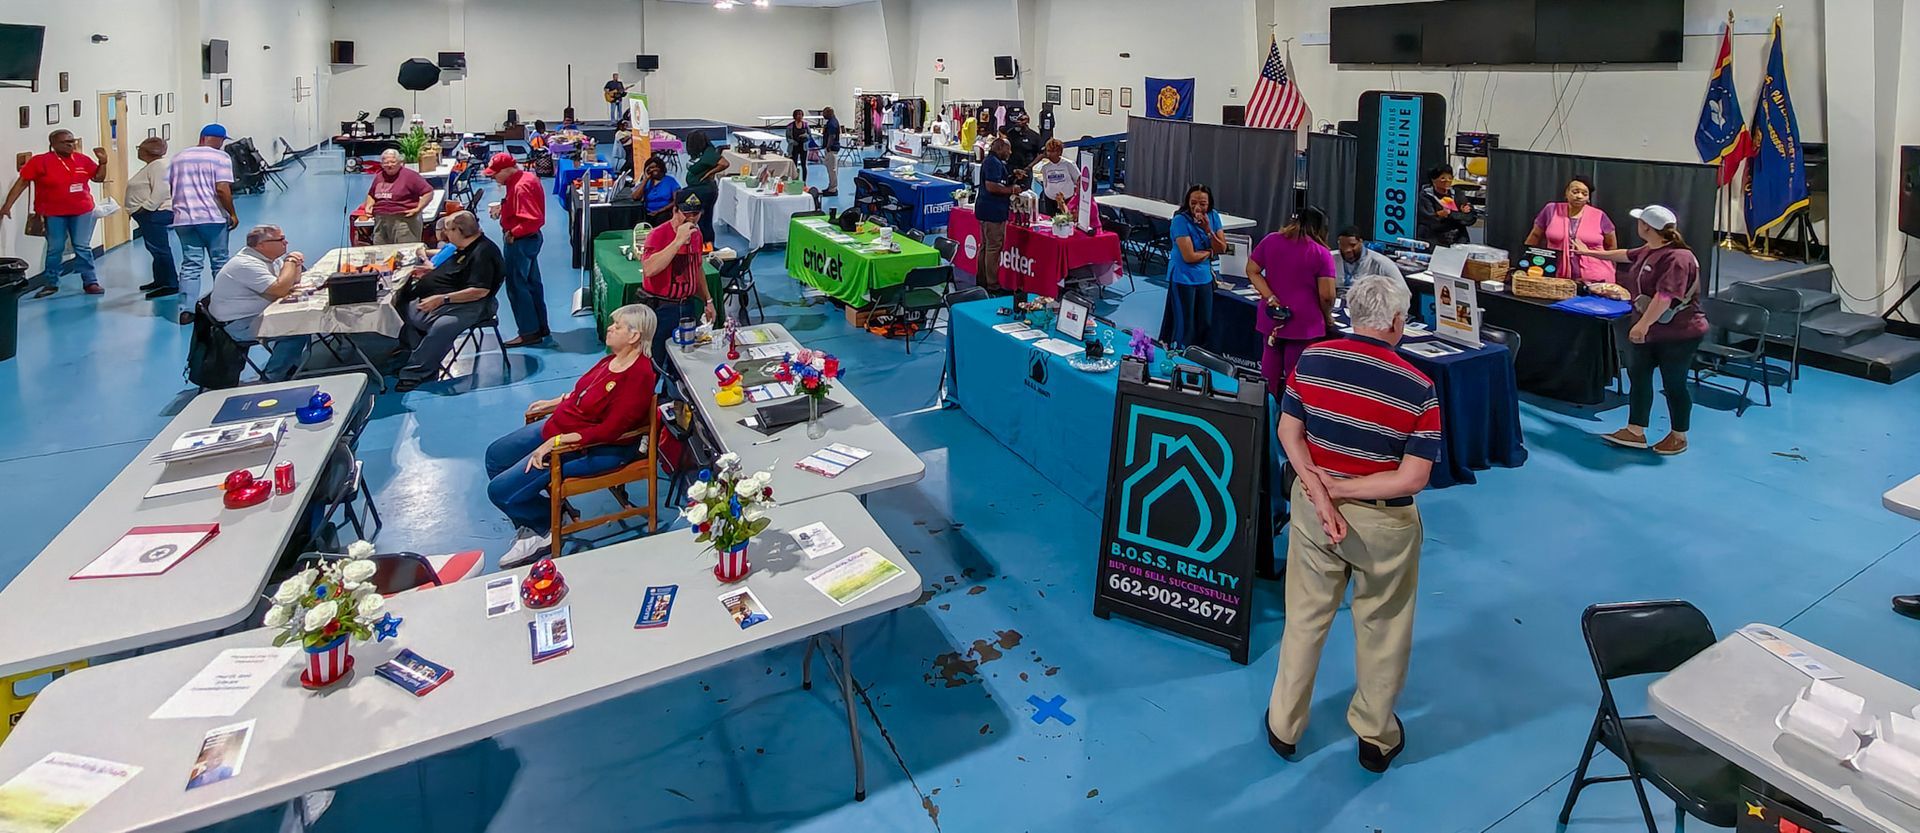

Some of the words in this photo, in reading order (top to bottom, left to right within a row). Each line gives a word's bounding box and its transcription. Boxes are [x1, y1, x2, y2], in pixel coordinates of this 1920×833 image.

[1386, 147, 1395, 181] SUICIDE
[1396, 108, 1411, 184] LIFELINE
[1384, 188, 1407, 235] 988
[803, 245, 843, 282] cricket
[1109, 559, 1128, 572] BUY
[1129, 565, 1143, 576] OR
[1145, 569, 1167, 583] SELL
[1169, 577, 1240, 605] SUCCESSFULLY
[1111, 542, 1171, 571] B.O.S.S.
[1177, 560, 1239, 590] REALTY
[1109, 573, 1237, 625] 662-902-2677
